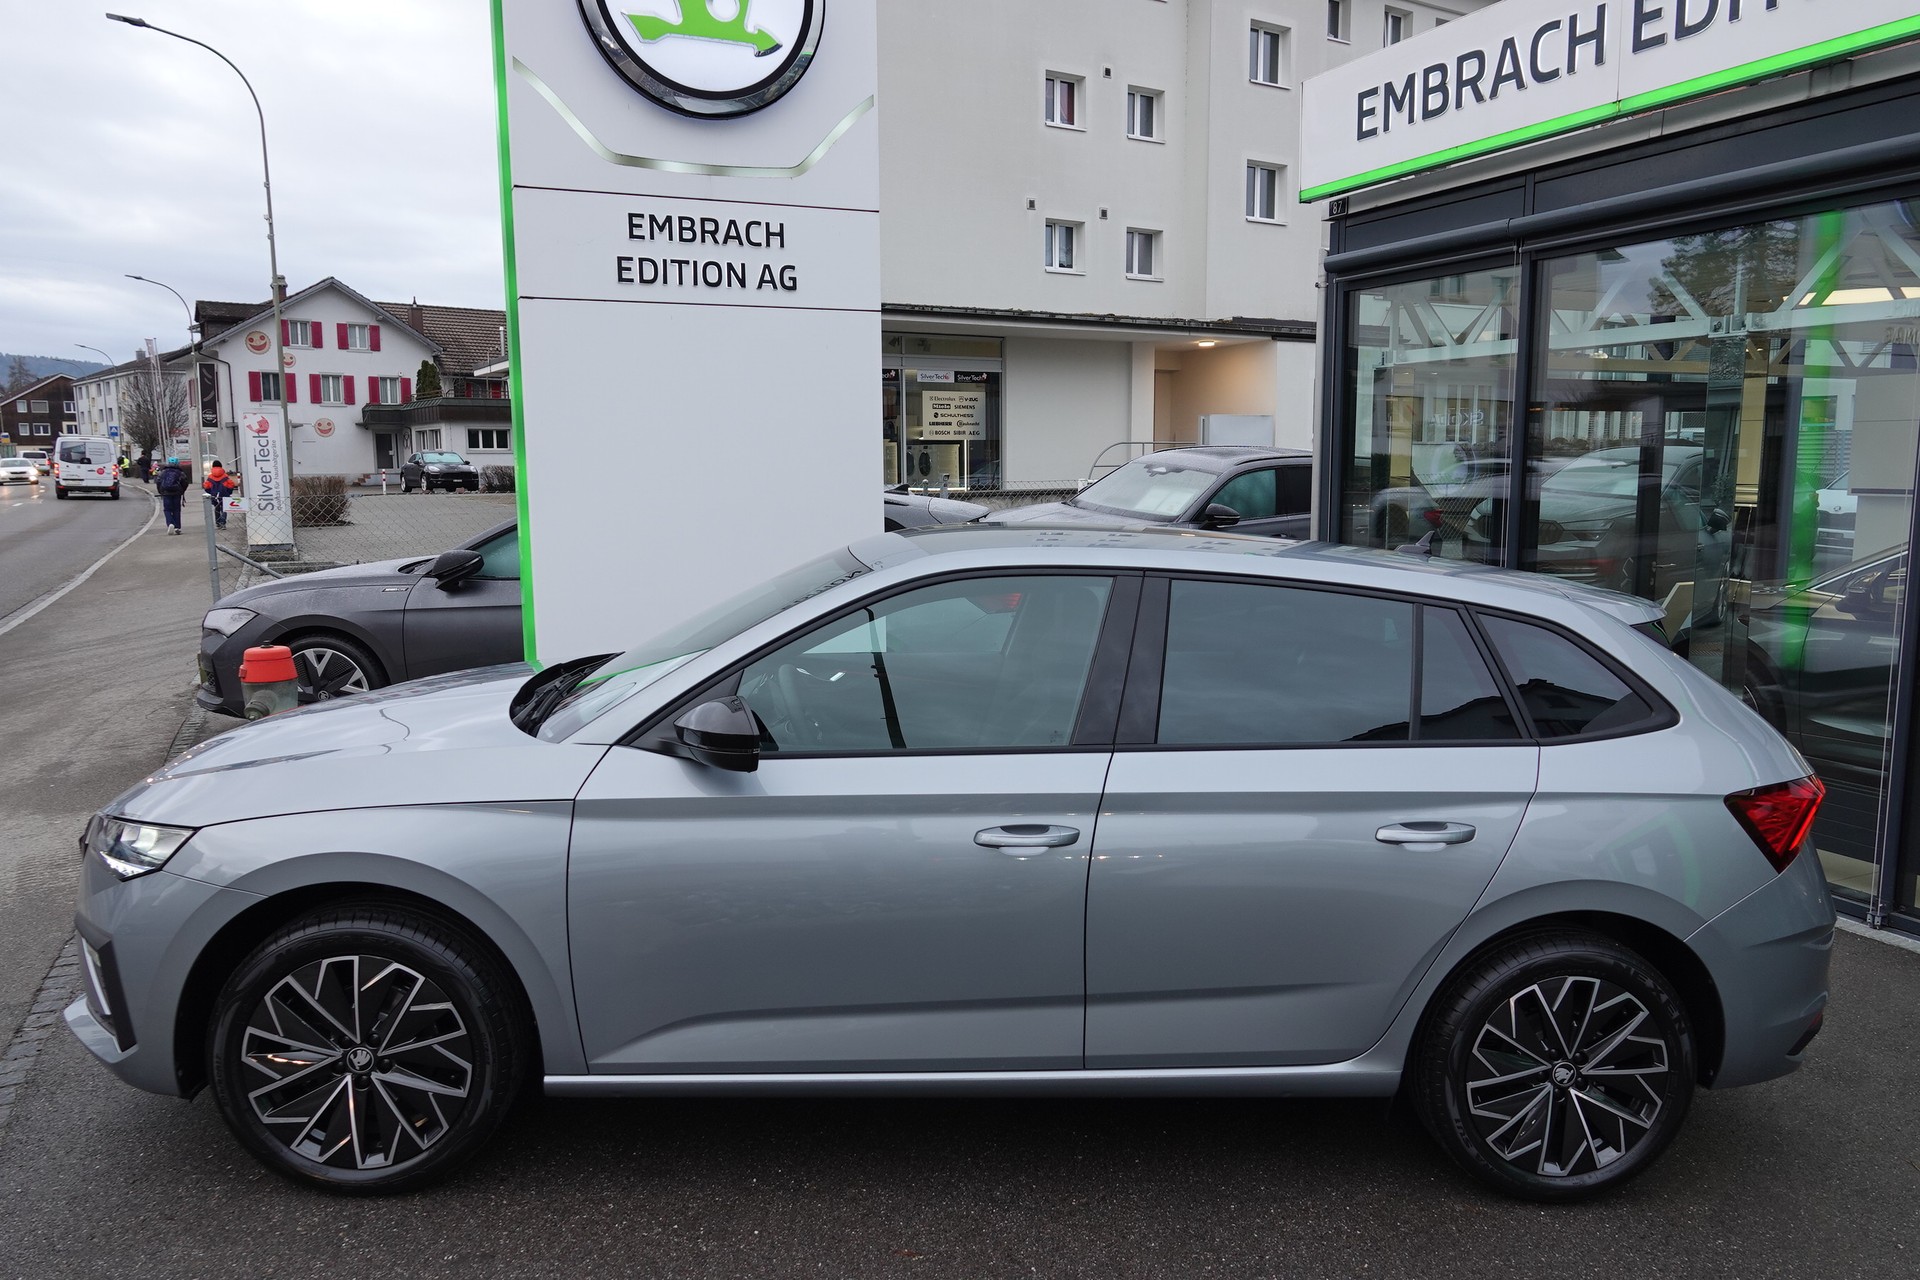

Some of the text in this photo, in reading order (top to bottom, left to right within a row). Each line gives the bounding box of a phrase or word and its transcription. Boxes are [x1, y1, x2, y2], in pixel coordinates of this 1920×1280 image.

[1357, 3, 1607, 141] EMBRACH
[1332, 201, 1343, 214] 87
[628, 213, 785, 249] EMBRACH
[617, 256, 797, 291] EDITION AG
